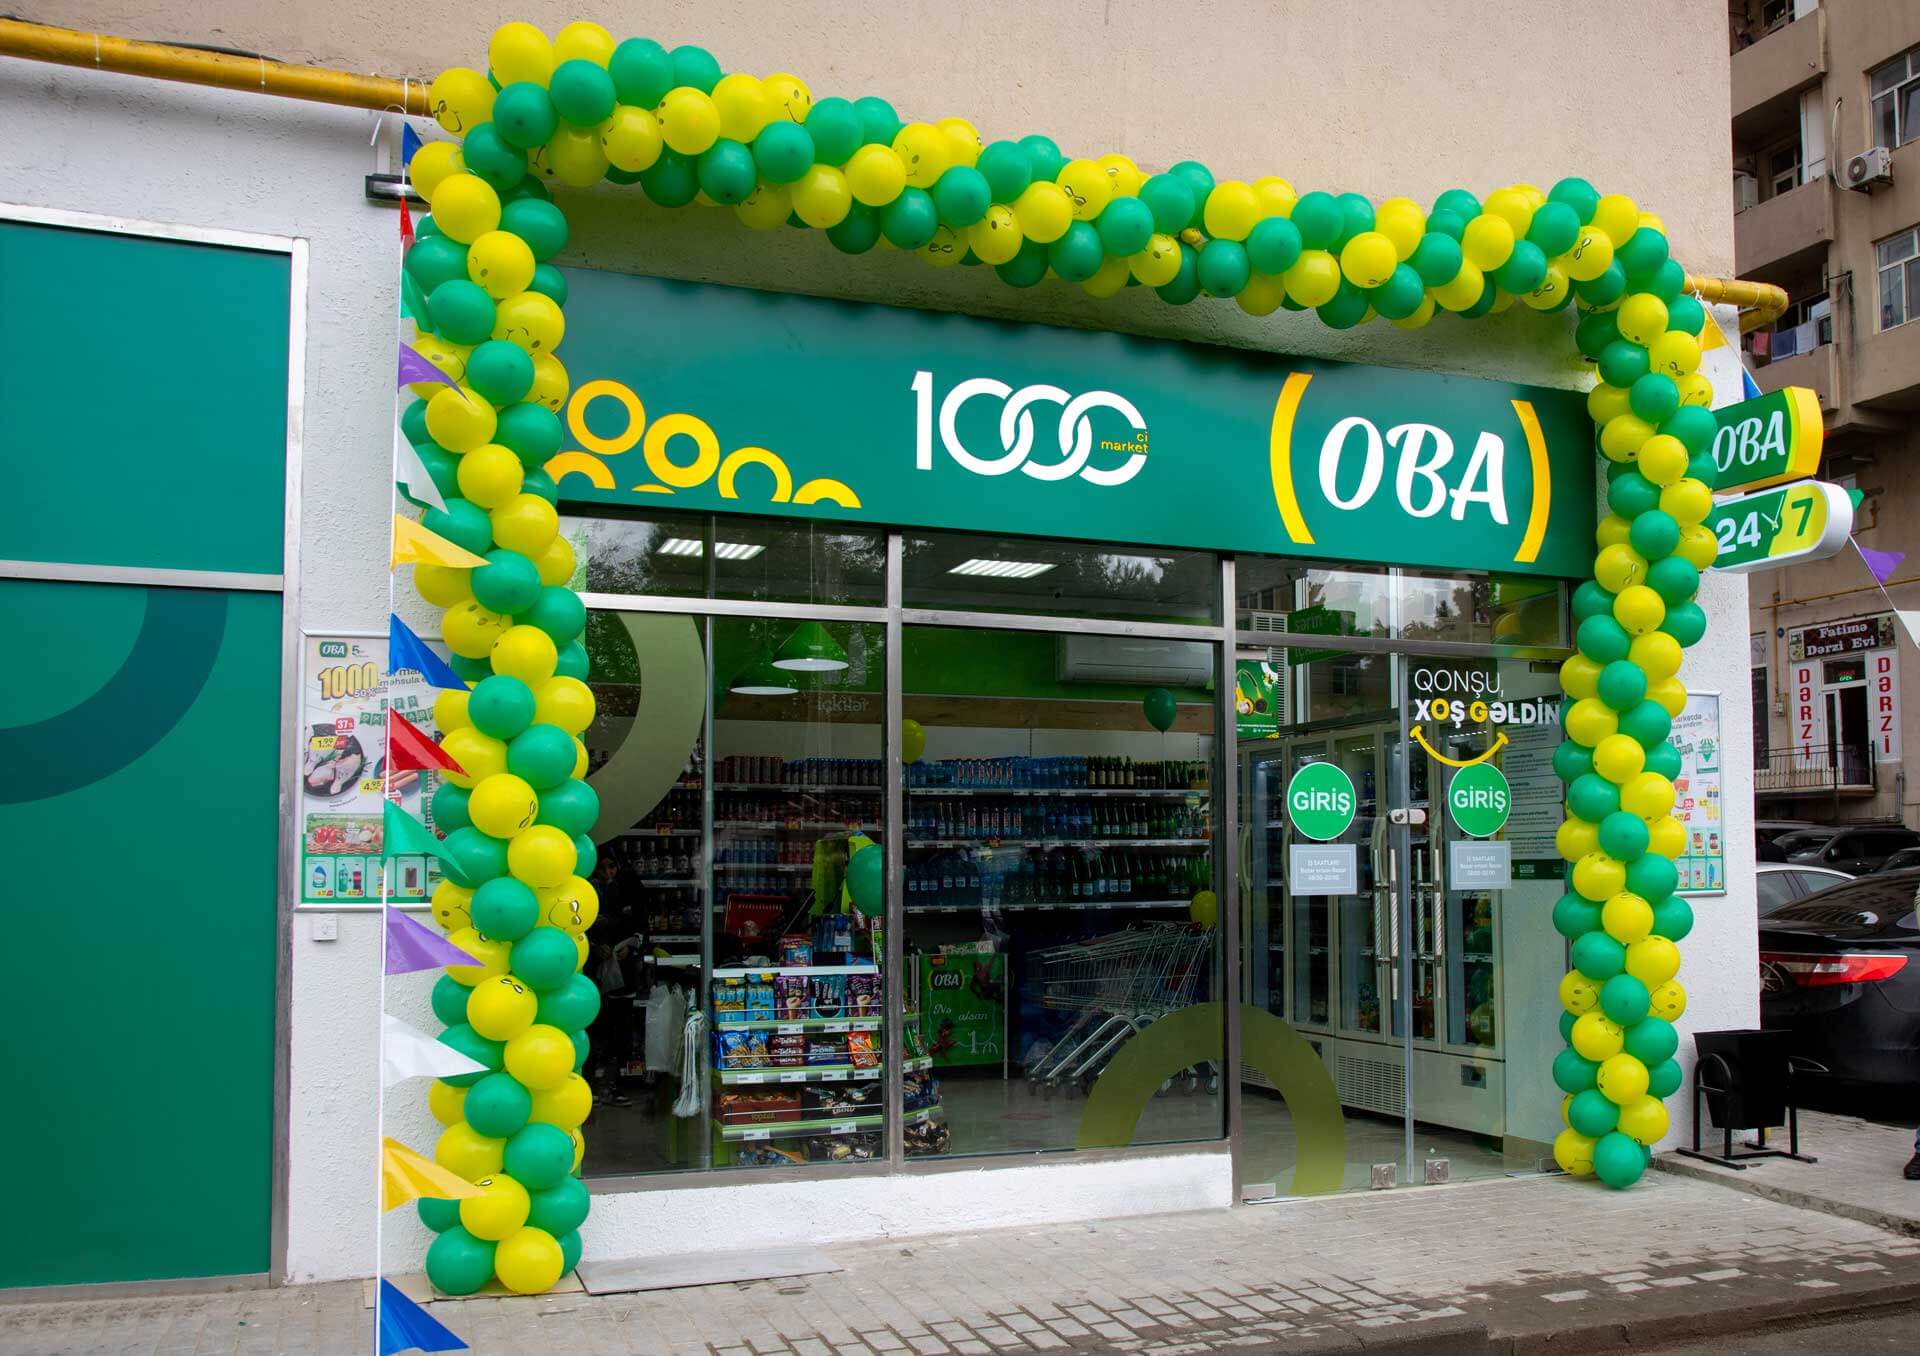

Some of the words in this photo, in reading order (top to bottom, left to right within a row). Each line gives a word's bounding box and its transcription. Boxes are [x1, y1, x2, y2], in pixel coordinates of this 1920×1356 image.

[911, 370, 1148, 486] 1000
[1137, 430, 1148, 442] ci
[1712, 411, 1786, 472] OBA
[1101, 440, 1148, 453] market
[1318, 416, 1509, 525] OBA
[1791, 497, 1813, 537] 7
[1819, 622, 1868, 639] Fatimə
[322, 644, 345, 655] OBA
[1807, 640, 1843, 657] Dərzi
[1851, 635, 1876, 649] Evi
[1414, 668, 1504, 699] QONŞU,
[1414, 698, 1465, 729] XOŞ
[1470, 697, 1560, 725] GƏLDİN
[1293, 787, 1351, 816] GİRİŞ
[1453, 785, 1506, 813] GİRİŞ
[934, 973, 960, 986] OBA
